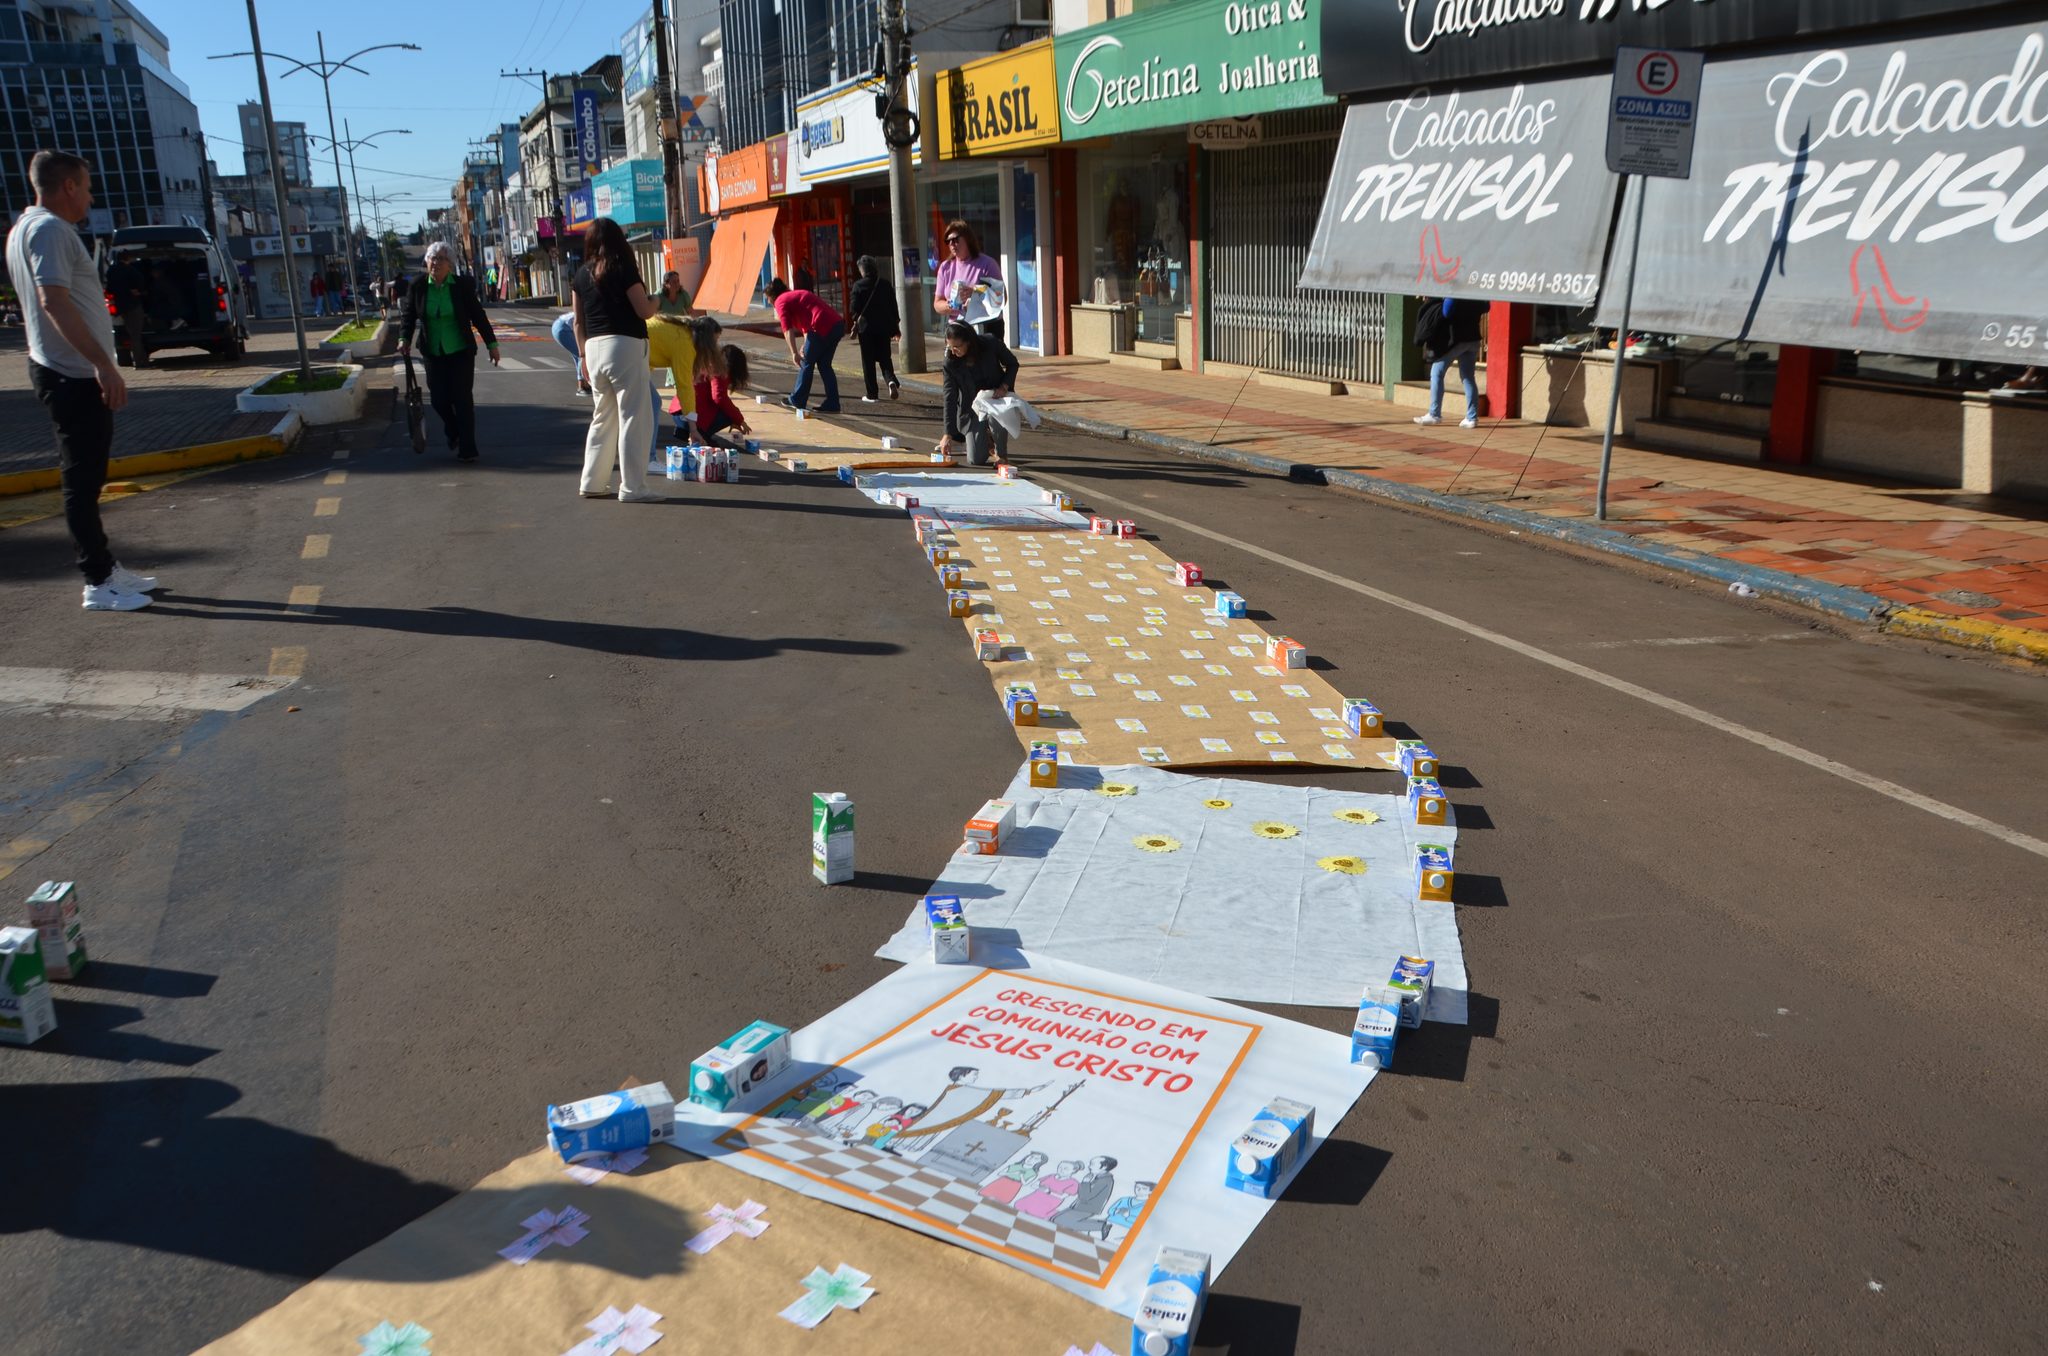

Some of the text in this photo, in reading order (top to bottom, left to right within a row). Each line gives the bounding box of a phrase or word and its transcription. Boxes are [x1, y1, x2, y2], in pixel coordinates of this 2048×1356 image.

[1065, 35, 1200, 124] Getelina
[1219, 41, 1320, 93] Joalheria
[1648, 61, 1667, 86] E
[581, 97, 597, 162] Colombo
[811, 120, 832, 148] SPEED
[953, 84, 1038, 144] BRASIL
[1194, 124, 1257, 139] GETELINA
[1386, 83, 1557, 160] Calçados
[1618, 100, 1689, 117] ZONA AZUL
[1341, 153, 1573, 224] TREVISOL
[1480, 271, 1595, 295] 55 99941-8367
[2004, 325, 2037, 348] 55
[968, 1005, 1200, 1065] COMUNHÃO COM
[996, 989, 1208, 1043] CRESCENDO EM
[931, 1022, 1194, 1093] JESUS CRISTO
[1241, 1133, 1278, 1150] Italac
[1143, 1305, 1187, 1322] Italac
